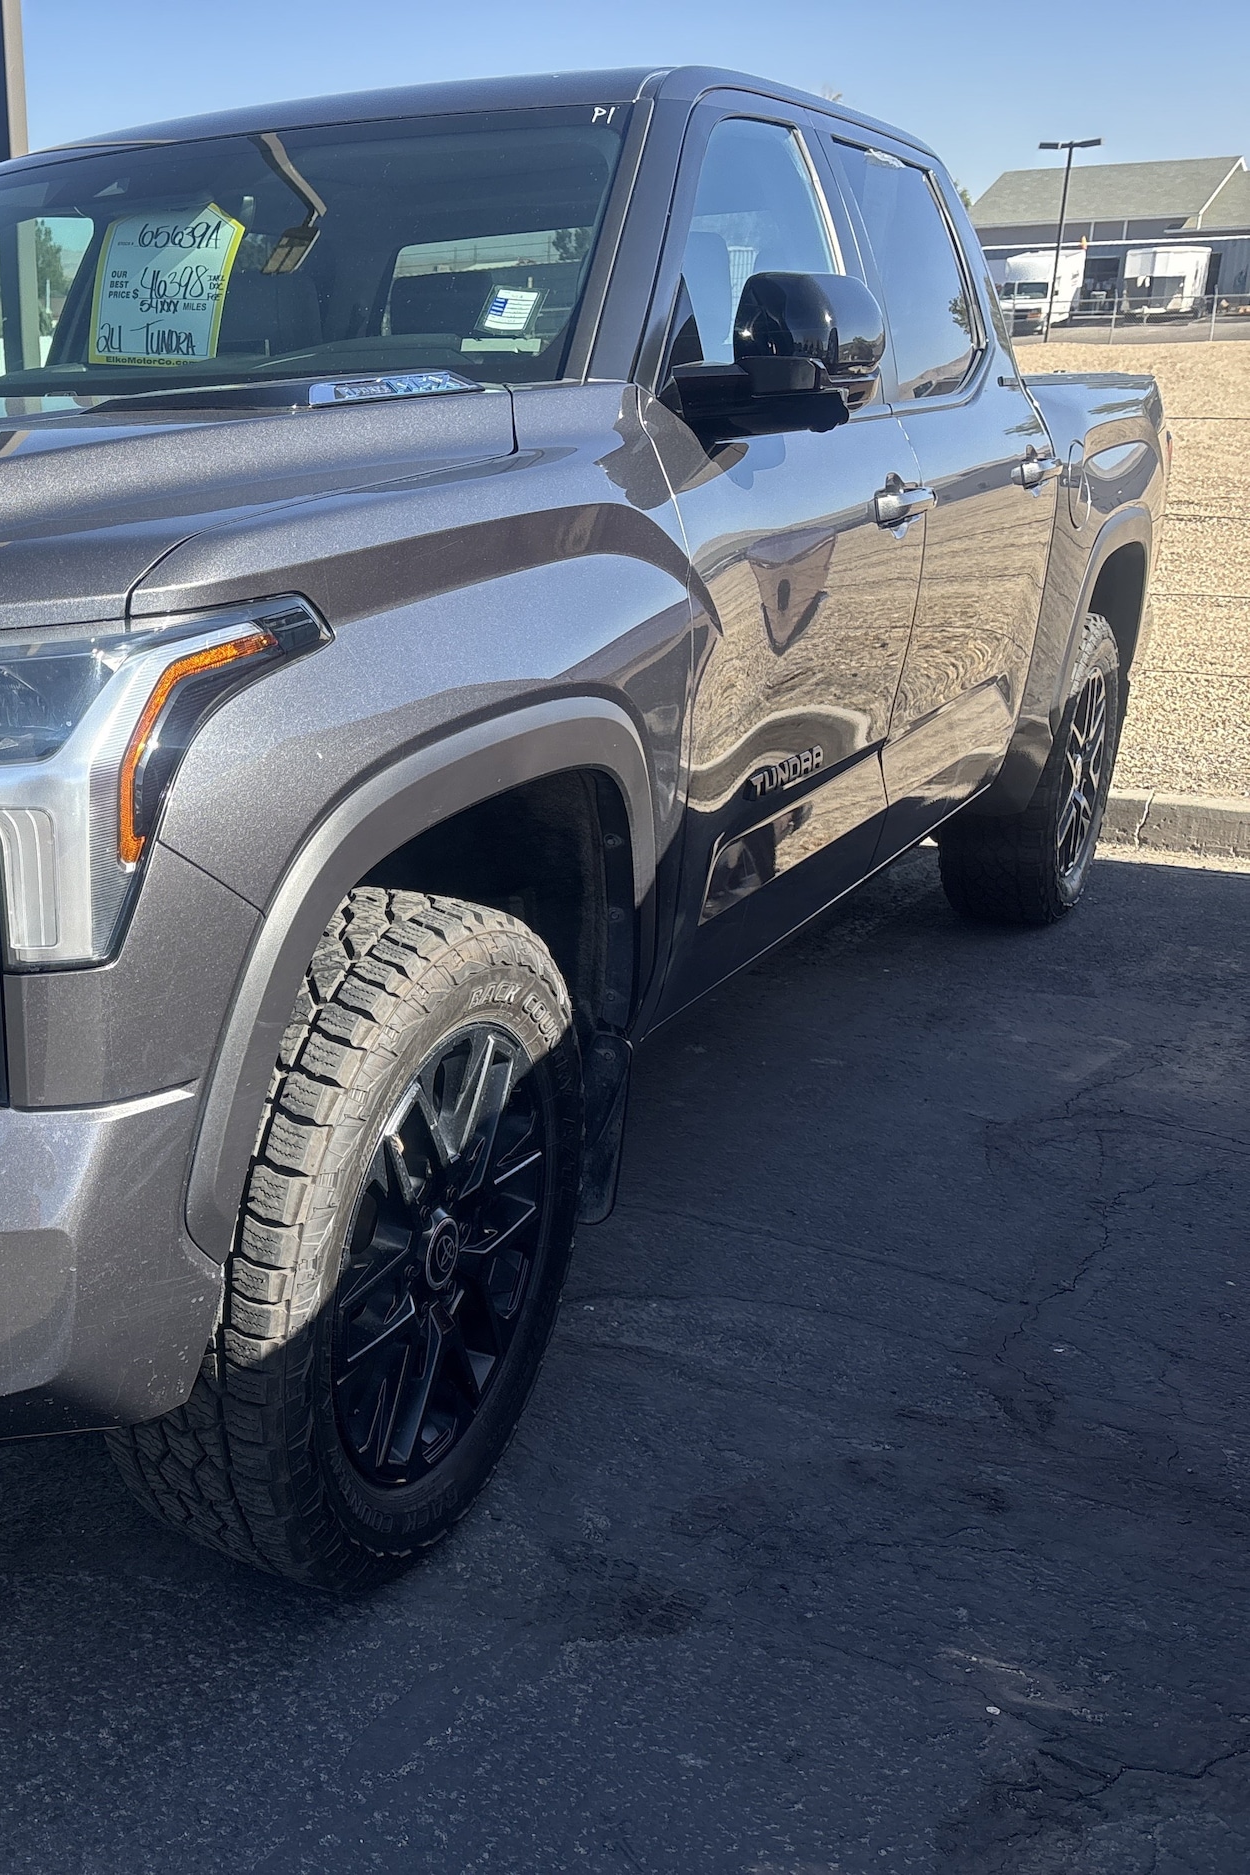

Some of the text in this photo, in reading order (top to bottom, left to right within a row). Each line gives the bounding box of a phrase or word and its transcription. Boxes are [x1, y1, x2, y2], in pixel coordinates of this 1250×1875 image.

[138, 220, 222, 249] 65639A
[108, 291, 131, 299] PRICE
[140, 265, 209, 300] 46398
[110, 281, 129, 289] BEST
[111, 270, 128, 278] OUR
[182, 302, 207, 311] MILES
[96, 319, 196, 355] 24 TUNDRA
[750, 744, 823, 796] TUNDRA
